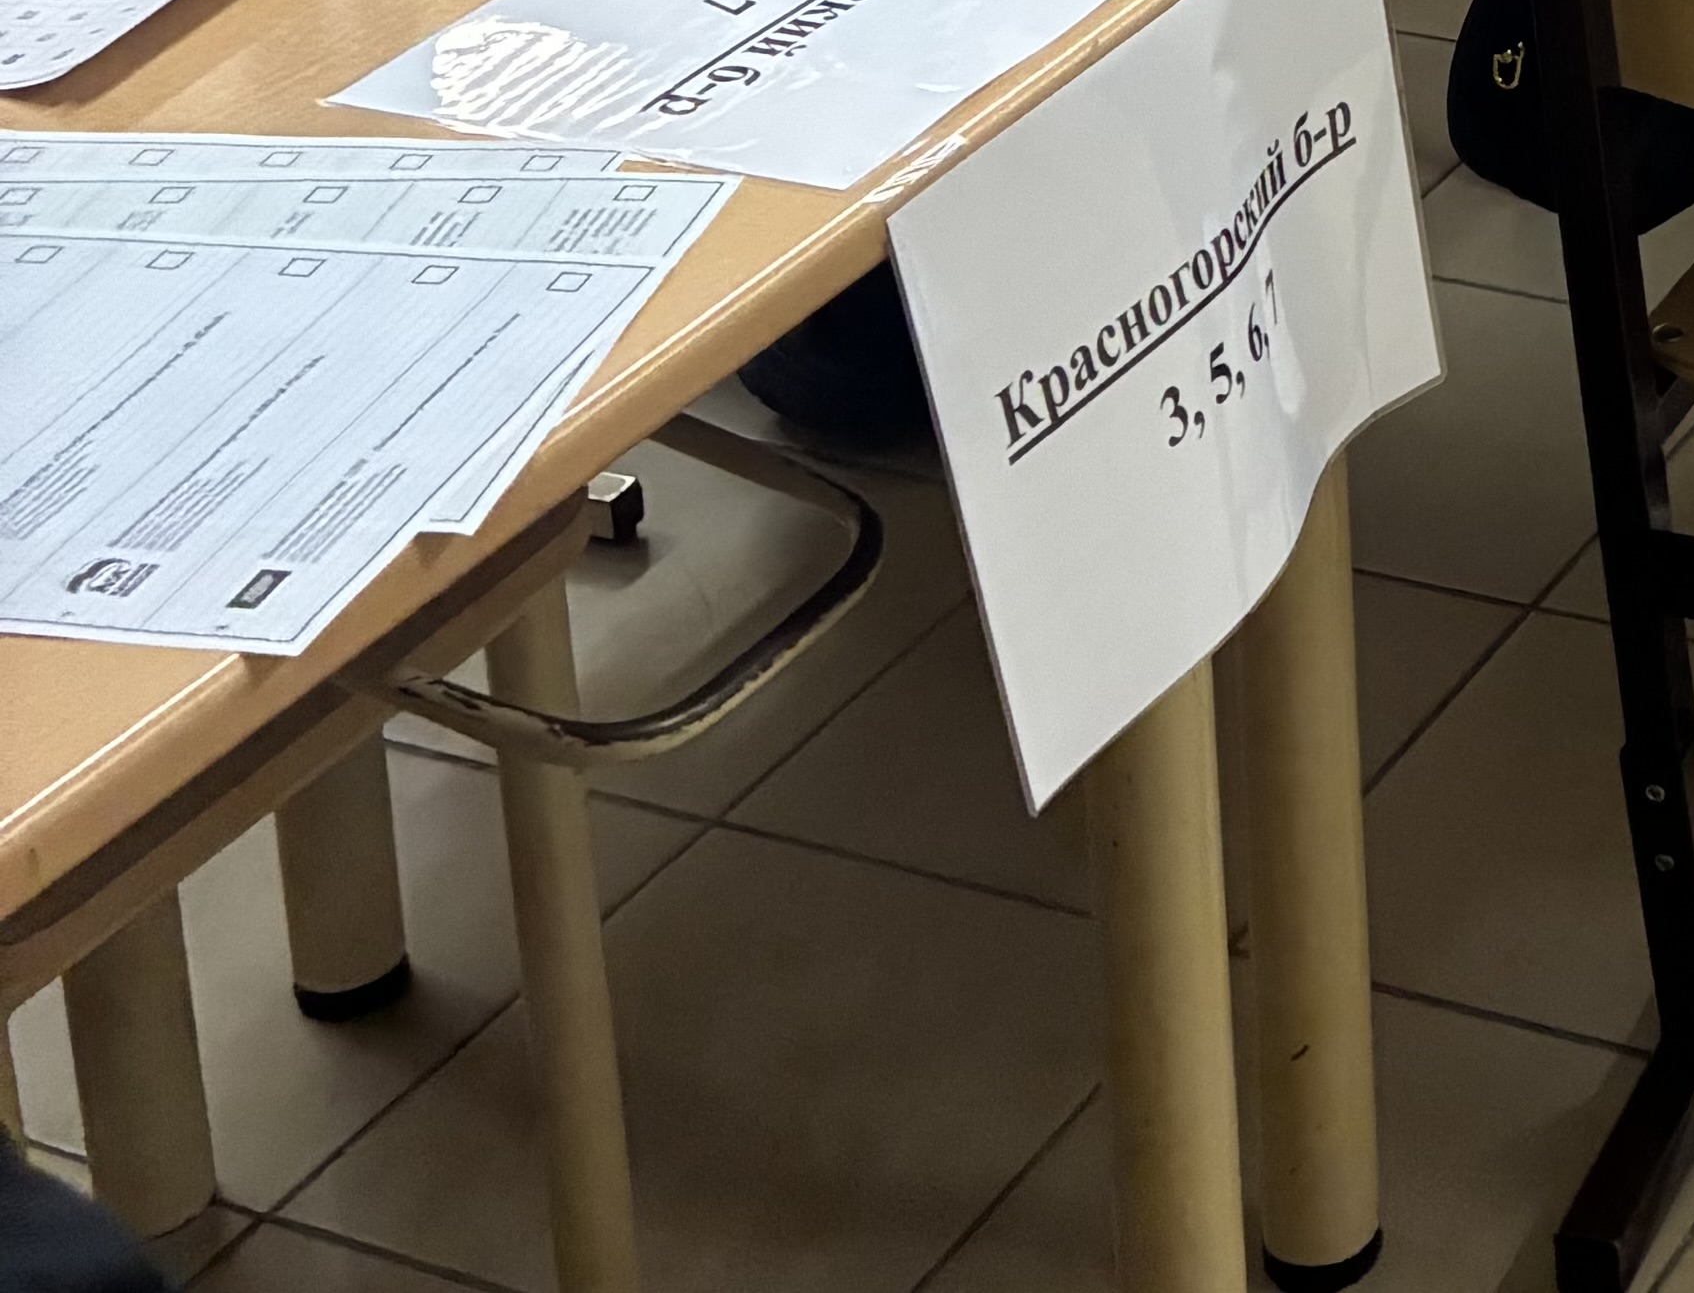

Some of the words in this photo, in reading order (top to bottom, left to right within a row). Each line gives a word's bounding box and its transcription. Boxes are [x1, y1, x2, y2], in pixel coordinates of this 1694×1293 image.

[655, 64, 762, 117] б-р
[994, 139, 1288, 451] Красногорский
[1293, 101, 1353, 168] б-р
